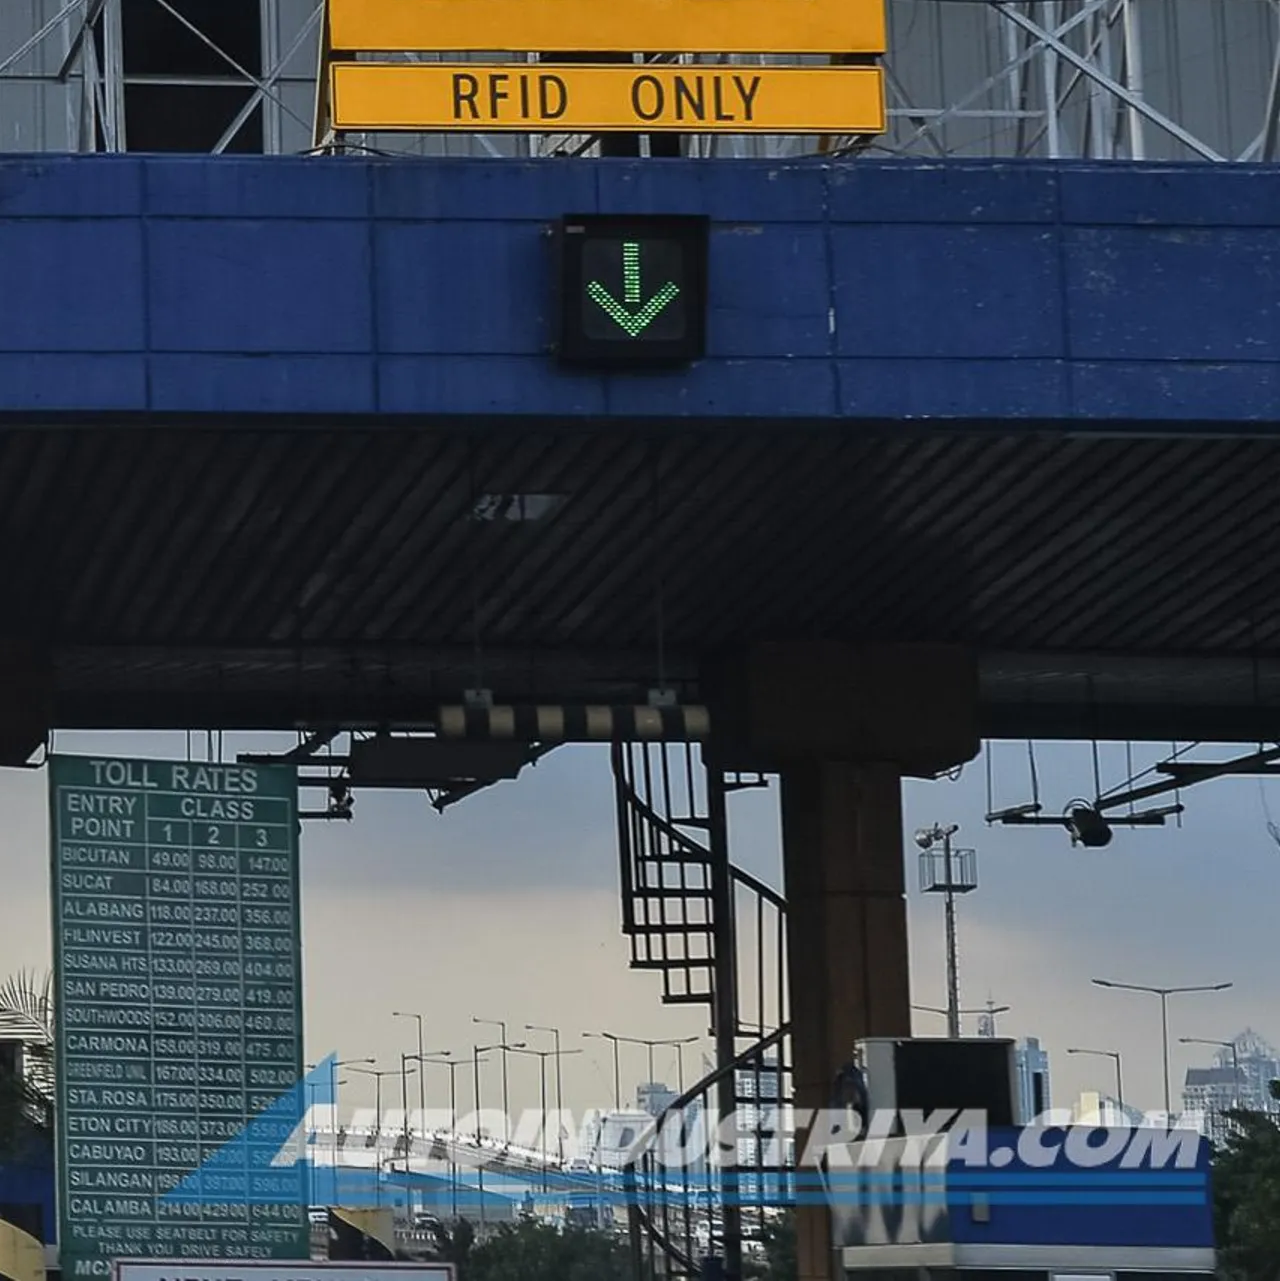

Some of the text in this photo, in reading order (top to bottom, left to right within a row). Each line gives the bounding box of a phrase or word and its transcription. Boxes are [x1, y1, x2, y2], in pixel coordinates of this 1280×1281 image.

[453, 74, 761, 121] RFID ONLY
[91, 761, 257, 792] TOLL RATES
[67, 794, 136, 815] ENTRY
[181, 798, 254, 819] CLASS
[71, 818, 135, 837] POINT
[163, 824, 268, 846] 1 2 3
[63, 847, 189, 866] BICUTAN 49.00
[63, 874, 289, 897] SUCAT 252.00
[64, 901, 143, 918] ALABANG
[64, 929, 140, 943] FILINVEST
[64, 954, 117, 970] SUSANA
[66, 981, 149, 998] SAN PEDRO
[66, 1009, 151, 1025] SOUTHWOODS
[67, 1037, 148, 1052] CARMONA
[103, 1091, 147, 1105] ROSA
[69, 1117, 151, 1133] ETON CITY
[70, 1145, 146, 1159] CABUYAO
[71, 1173, 152, 1189] SILANGAN
[71, 1200, 151, 1215] CALAMBA
[73, 1227, 299, 1243] PLEASE USE SEATBELT FOR SAFETY
[98, 1243, 273, 1257] THANK YOU DRIVE SAFELY
